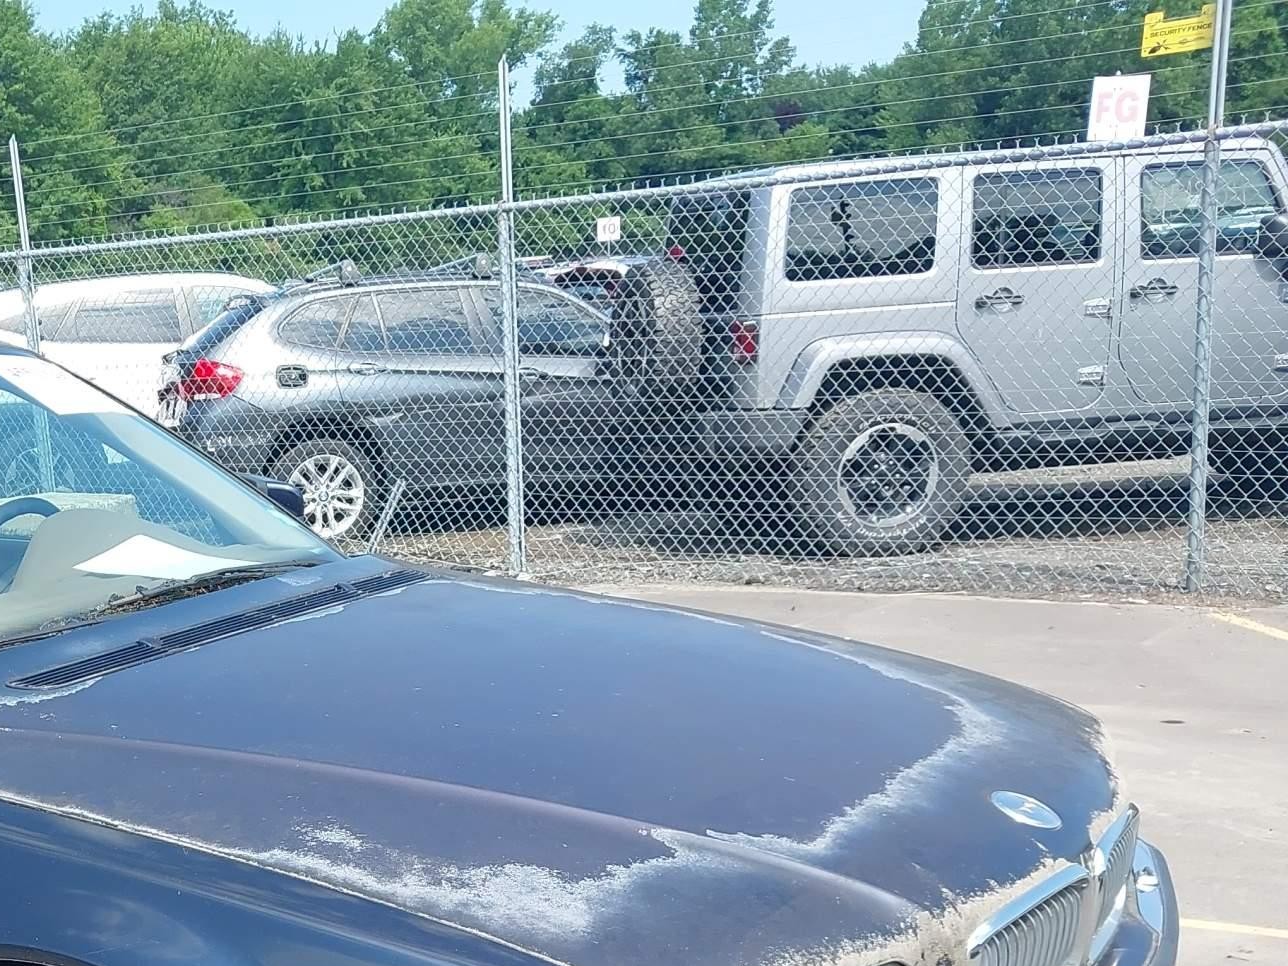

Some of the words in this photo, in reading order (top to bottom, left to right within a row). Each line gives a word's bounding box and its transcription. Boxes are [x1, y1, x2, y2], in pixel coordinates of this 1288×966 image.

[1150, 28, 1188, 38] SECURITY
[1187, 22, 1213, 32] FENCE
[1096, 90, 1139, 124] FG
